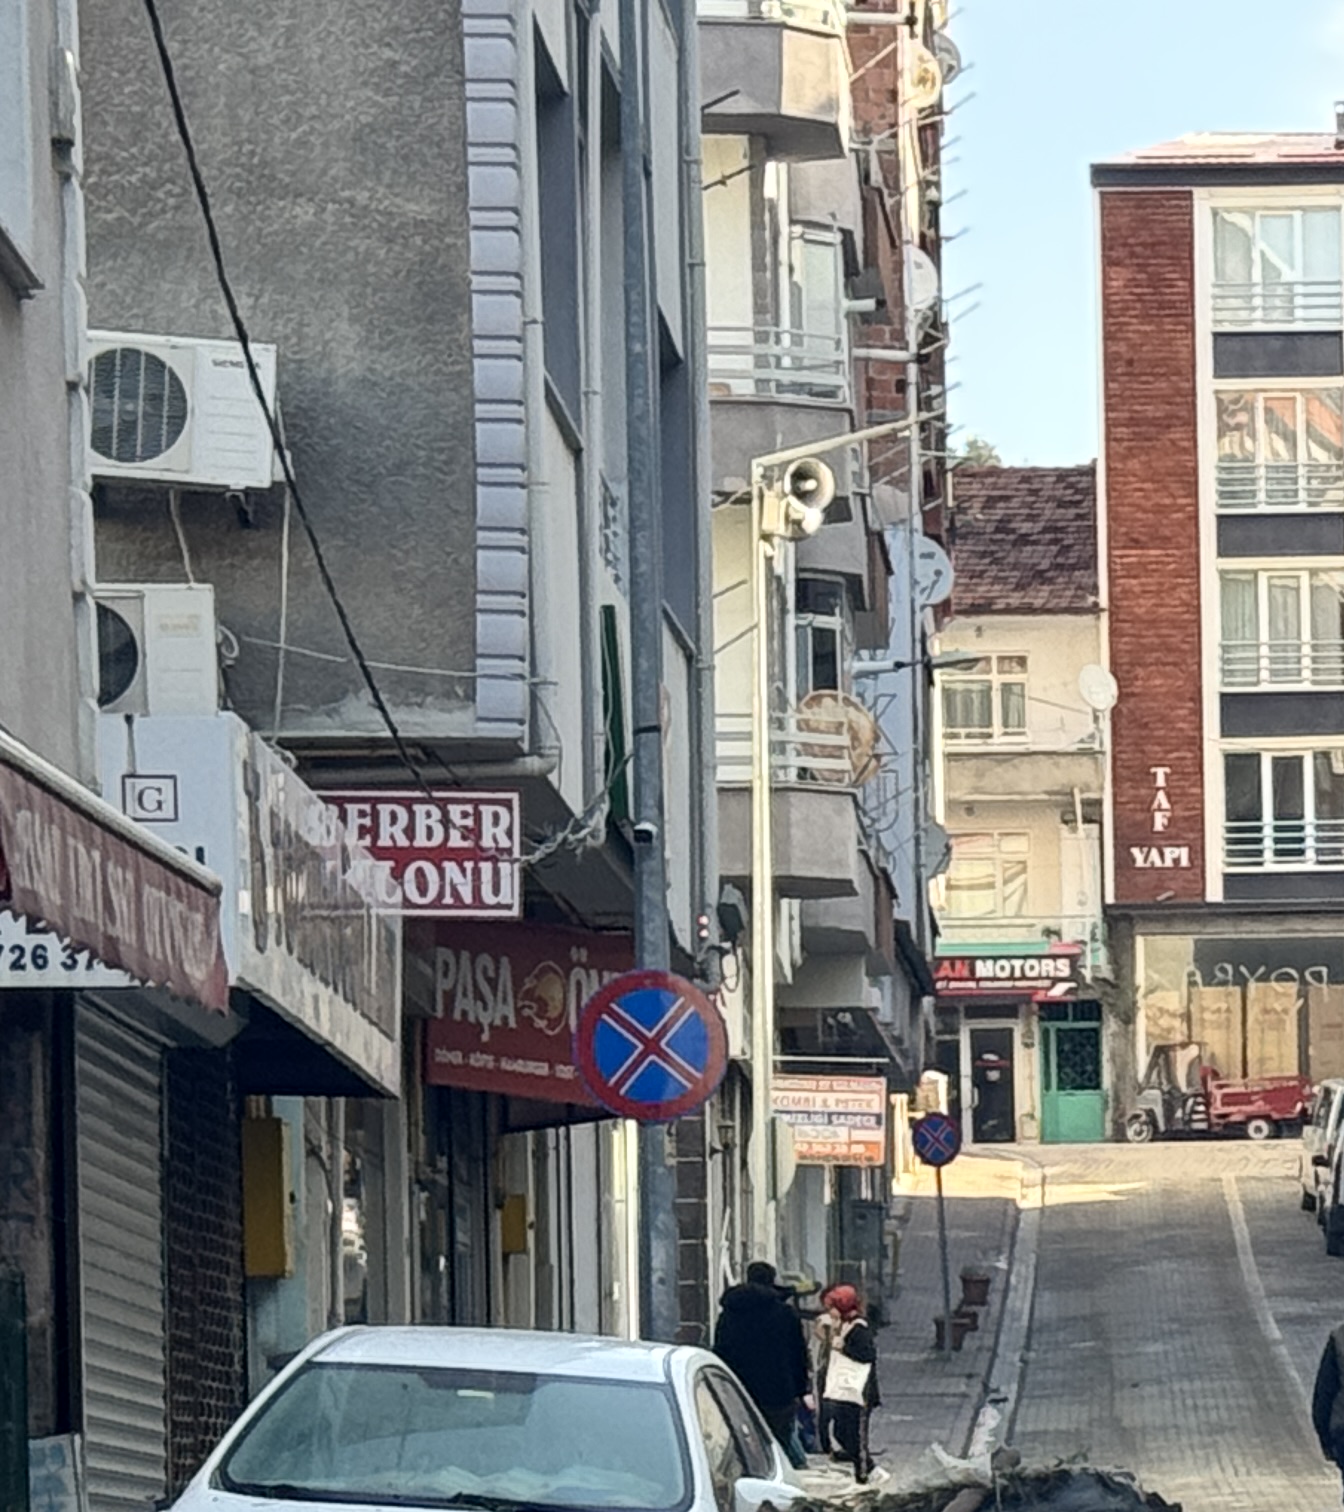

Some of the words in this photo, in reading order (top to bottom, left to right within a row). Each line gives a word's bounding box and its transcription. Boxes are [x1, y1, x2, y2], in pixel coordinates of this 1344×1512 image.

[1129, 846, 1192, 868] YAPI
[0, 943, 49, 972] 26
[975, 958, 1070, 978] MOTORS
[435, 946, 517, 1042] PAŞA
